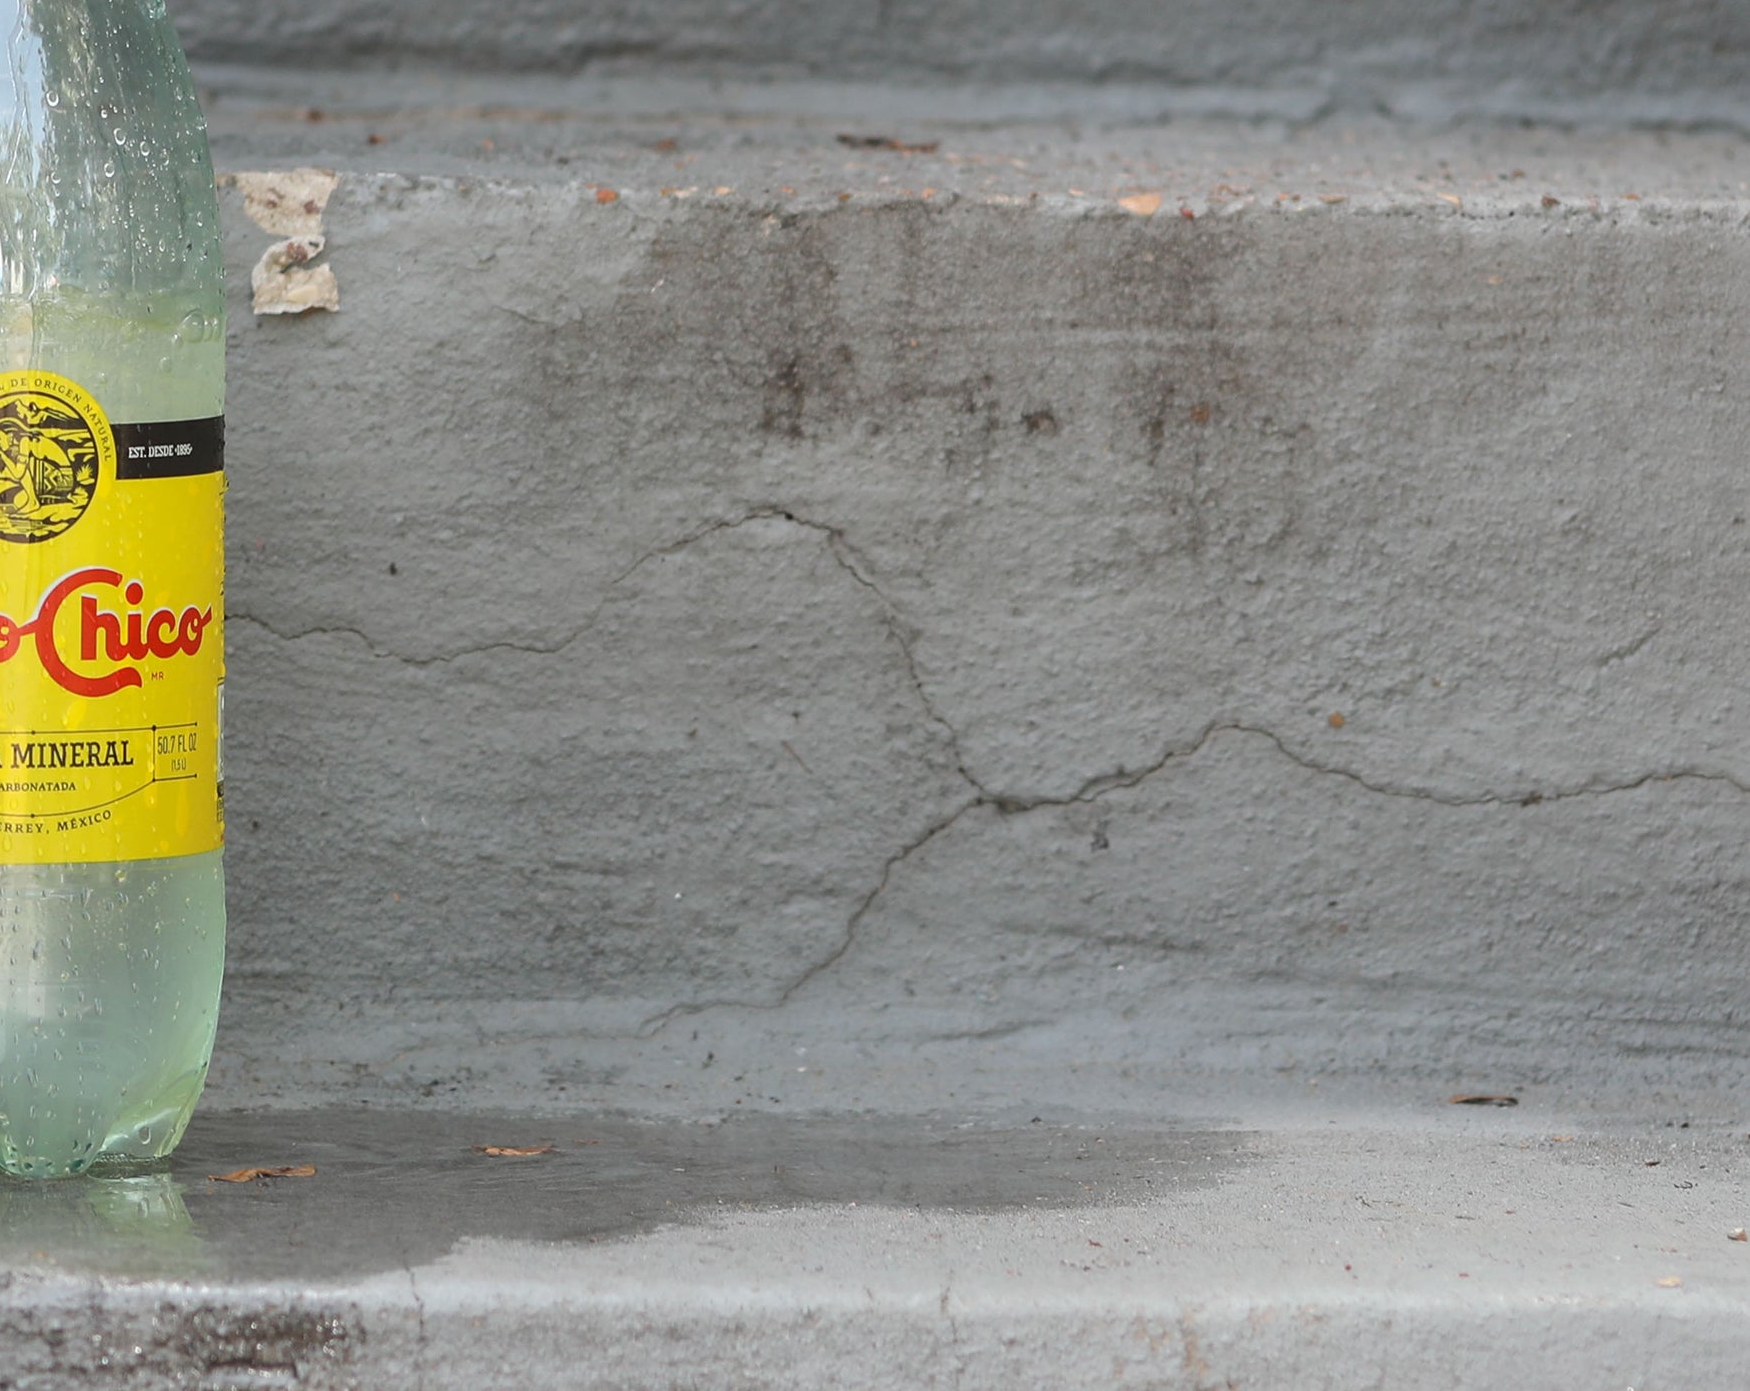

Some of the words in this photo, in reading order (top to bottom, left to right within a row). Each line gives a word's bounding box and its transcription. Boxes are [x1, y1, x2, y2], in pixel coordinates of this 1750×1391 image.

[10, 377, 27, 387] DE
[34, 378, 82, 403] ORIGEN
[83, 403, 112, 462] NATURAL
[128, 446, 146, 459] EST.
[148, 444, 174, 458] DESDE
[35, 564, 212, 698] Chico
[151, 672, 164, 681] MR
[10, 739, 135, 769] MINERAL
[157, 735, 176, 755] 50.7
[178, 734, 187, 752] FL
[188, 733, 197, 751] OZ
[56, 809, 113, 832] MÉXICO
